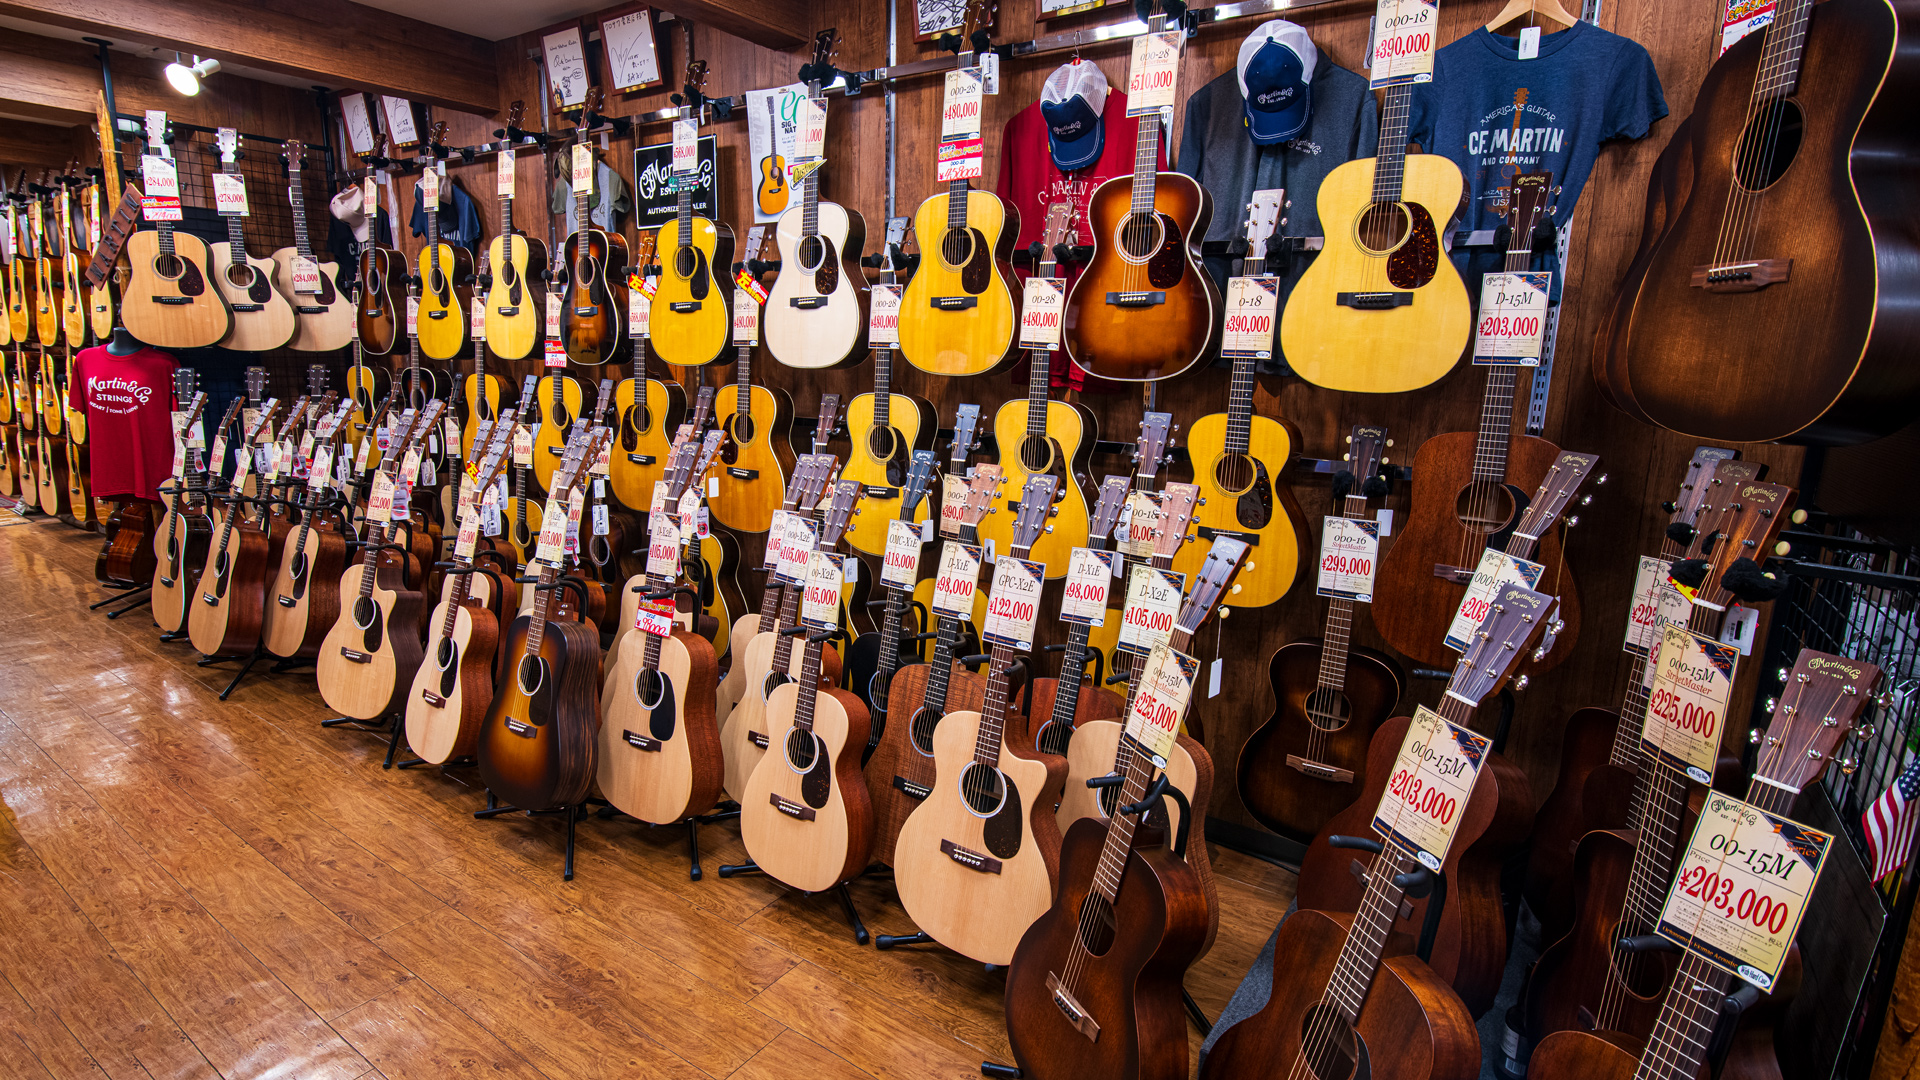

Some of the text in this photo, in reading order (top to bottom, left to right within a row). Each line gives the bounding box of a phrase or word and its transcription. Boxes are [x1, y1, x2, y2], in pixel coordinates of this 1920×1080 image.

[1385, 9, 1428, 28] 000-18
[1140, 48, 1170, 61] 000-28
[1375, 32, 1430, 60] ¥390,000
[950, 83, 976, 96] 000-28
[1130, 70, 1172, 92] ¥510,000
[944, 102, 978, 120] ¥480,000
[1480, 103, 1556, 126] AMERICA'S GUITAR
[1482, 156, 1540, 166] AND COMPANY
[218, 194, 244, 204] ¥278,000
[647, 206, 680, 216] AUTHORIZE
[90, 193, 140, 280] MARTIN
[876, 299, 896, 308] 000-28
[1032, 294, 1056, 304] 00-28
[1239, 295, 1262, 308] 0-18
[1496, 292, 1534, 308] D-15M
[870, 315, 898, 329] ¥480,000
[1022, 312, 1058, 328] ¥480,000
[1226, 315, 1270, 334] ¥390,000
[1479, 316, 1538, 340] ¥203,000
[89, 401, 106, 410] HEART
[96, 394, 132, 404] STRINGS
[788, 531, 812, 542] 000-X2E
[890, 534, 918, 548] OMC-X1E
[1334, 535, 1366, 544] 000-16
[650, 544, 676, 560] ¥105,000
[780, 546, 808, 564] ¥105,000
[1332, 542, 1366, 551] StreetMaster
[885, 552, 916, 570] ¥118,000
[948, 558, 970, 572] D-X1E
[1078, 564, 1100, 576] D-X1E
[1322, 554, 1371, 576] ¥299,000
[812, 568, 836, 580] 00-X2E
[998, 574, 1035, 592] GPC-X2E
[936, 576, 972, 596] ¥98,000
[1066, 582, 1104, 602] ¥98,000
[1140, 585, 1169, 602] D-X2E
[804, 586, 837, 606] ¥105,000
[989, 596, 1034, 622] ¥122,000
[1125, 606, 1172, 632] ¥105,000
[1153, 667, 1184, 689] 000-15M
[1670, 657, 1716, 684] 000-15M
[1665, 669, 1713, 696] StreetMaster
[1135, 692, 1177, 732] ¥225,000
[1650, 688, 1716, 740] ¥225,000
[1411, 740, 1467, 779] 000-15M
[1390, 769, 1456, 826] ¥203,000
[1689, 850, 1711, 864] Price
[1710, 834, 1798, 880] 00-15M
[1785, 842, 1818, 858] Series
[1678, 866, 1788, 934] ¥203,000
[1768, 936, 1783, 948] 税込
[1740, 965, 1768, 986] With Hard Case
